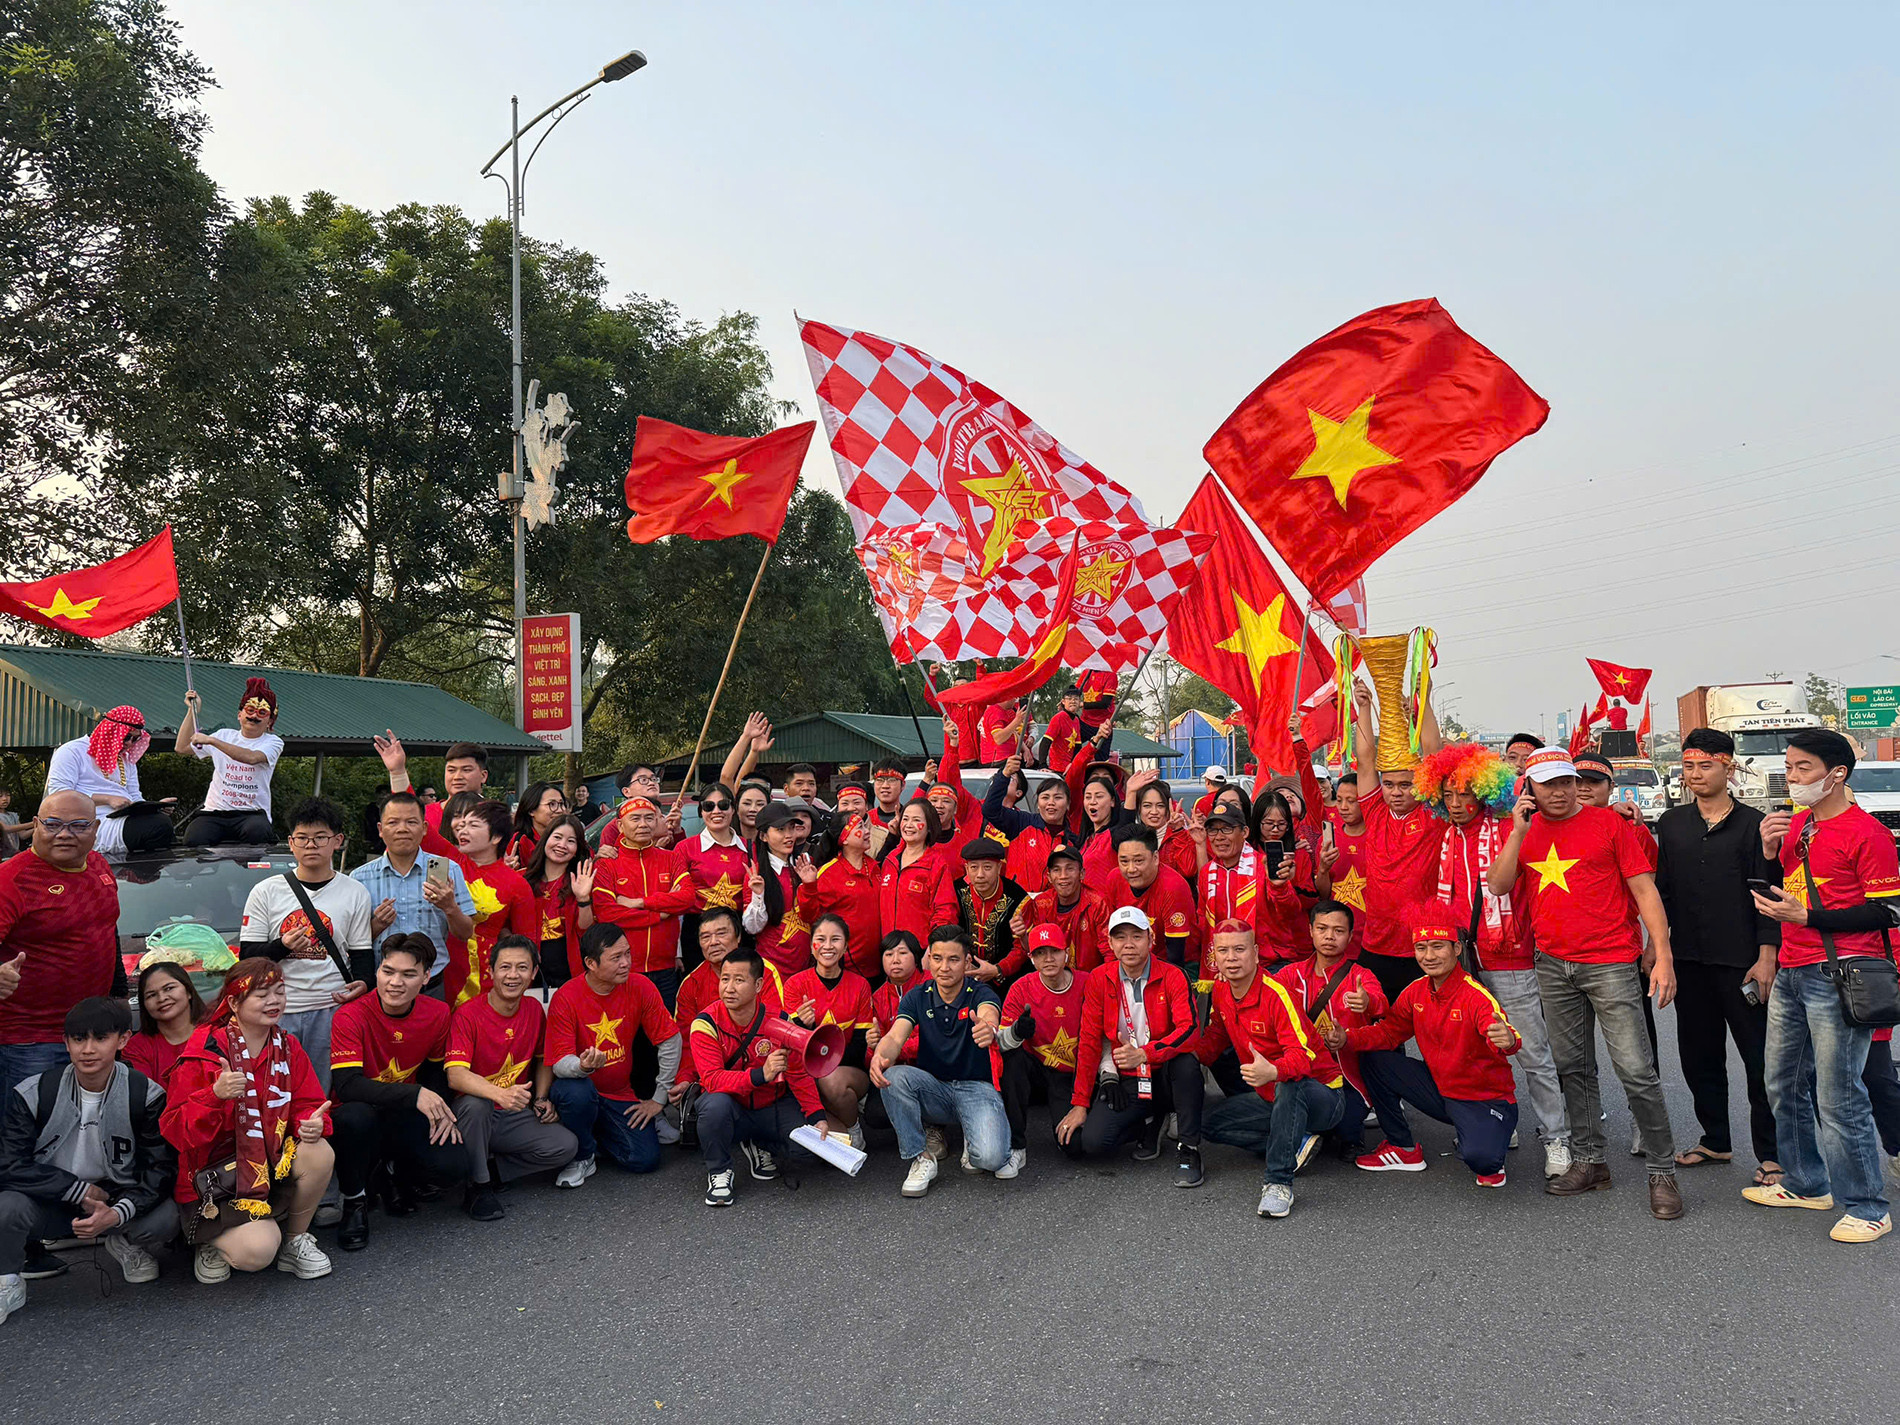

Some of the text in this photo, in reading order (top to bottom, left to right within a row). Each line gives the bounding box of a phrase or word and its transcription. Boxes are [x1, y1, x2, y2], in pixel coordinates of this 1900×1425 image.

[530, 627, 544, 638] XÂY
[528, 639, 567, 655] THÀNH PHỐ
[534, 659, 561, 672] VIỆT TRÌ
[548, 675, 567, 686] XANH
[551, 692, 565, 704] ĐẸP
[532, 706, 564, 720] BÌNH YÊN
[1850, 711, 1876, 719] LỐI VÀO
[225, 772, 243, 781] Road
[111, 1135, 132, 1165] P
